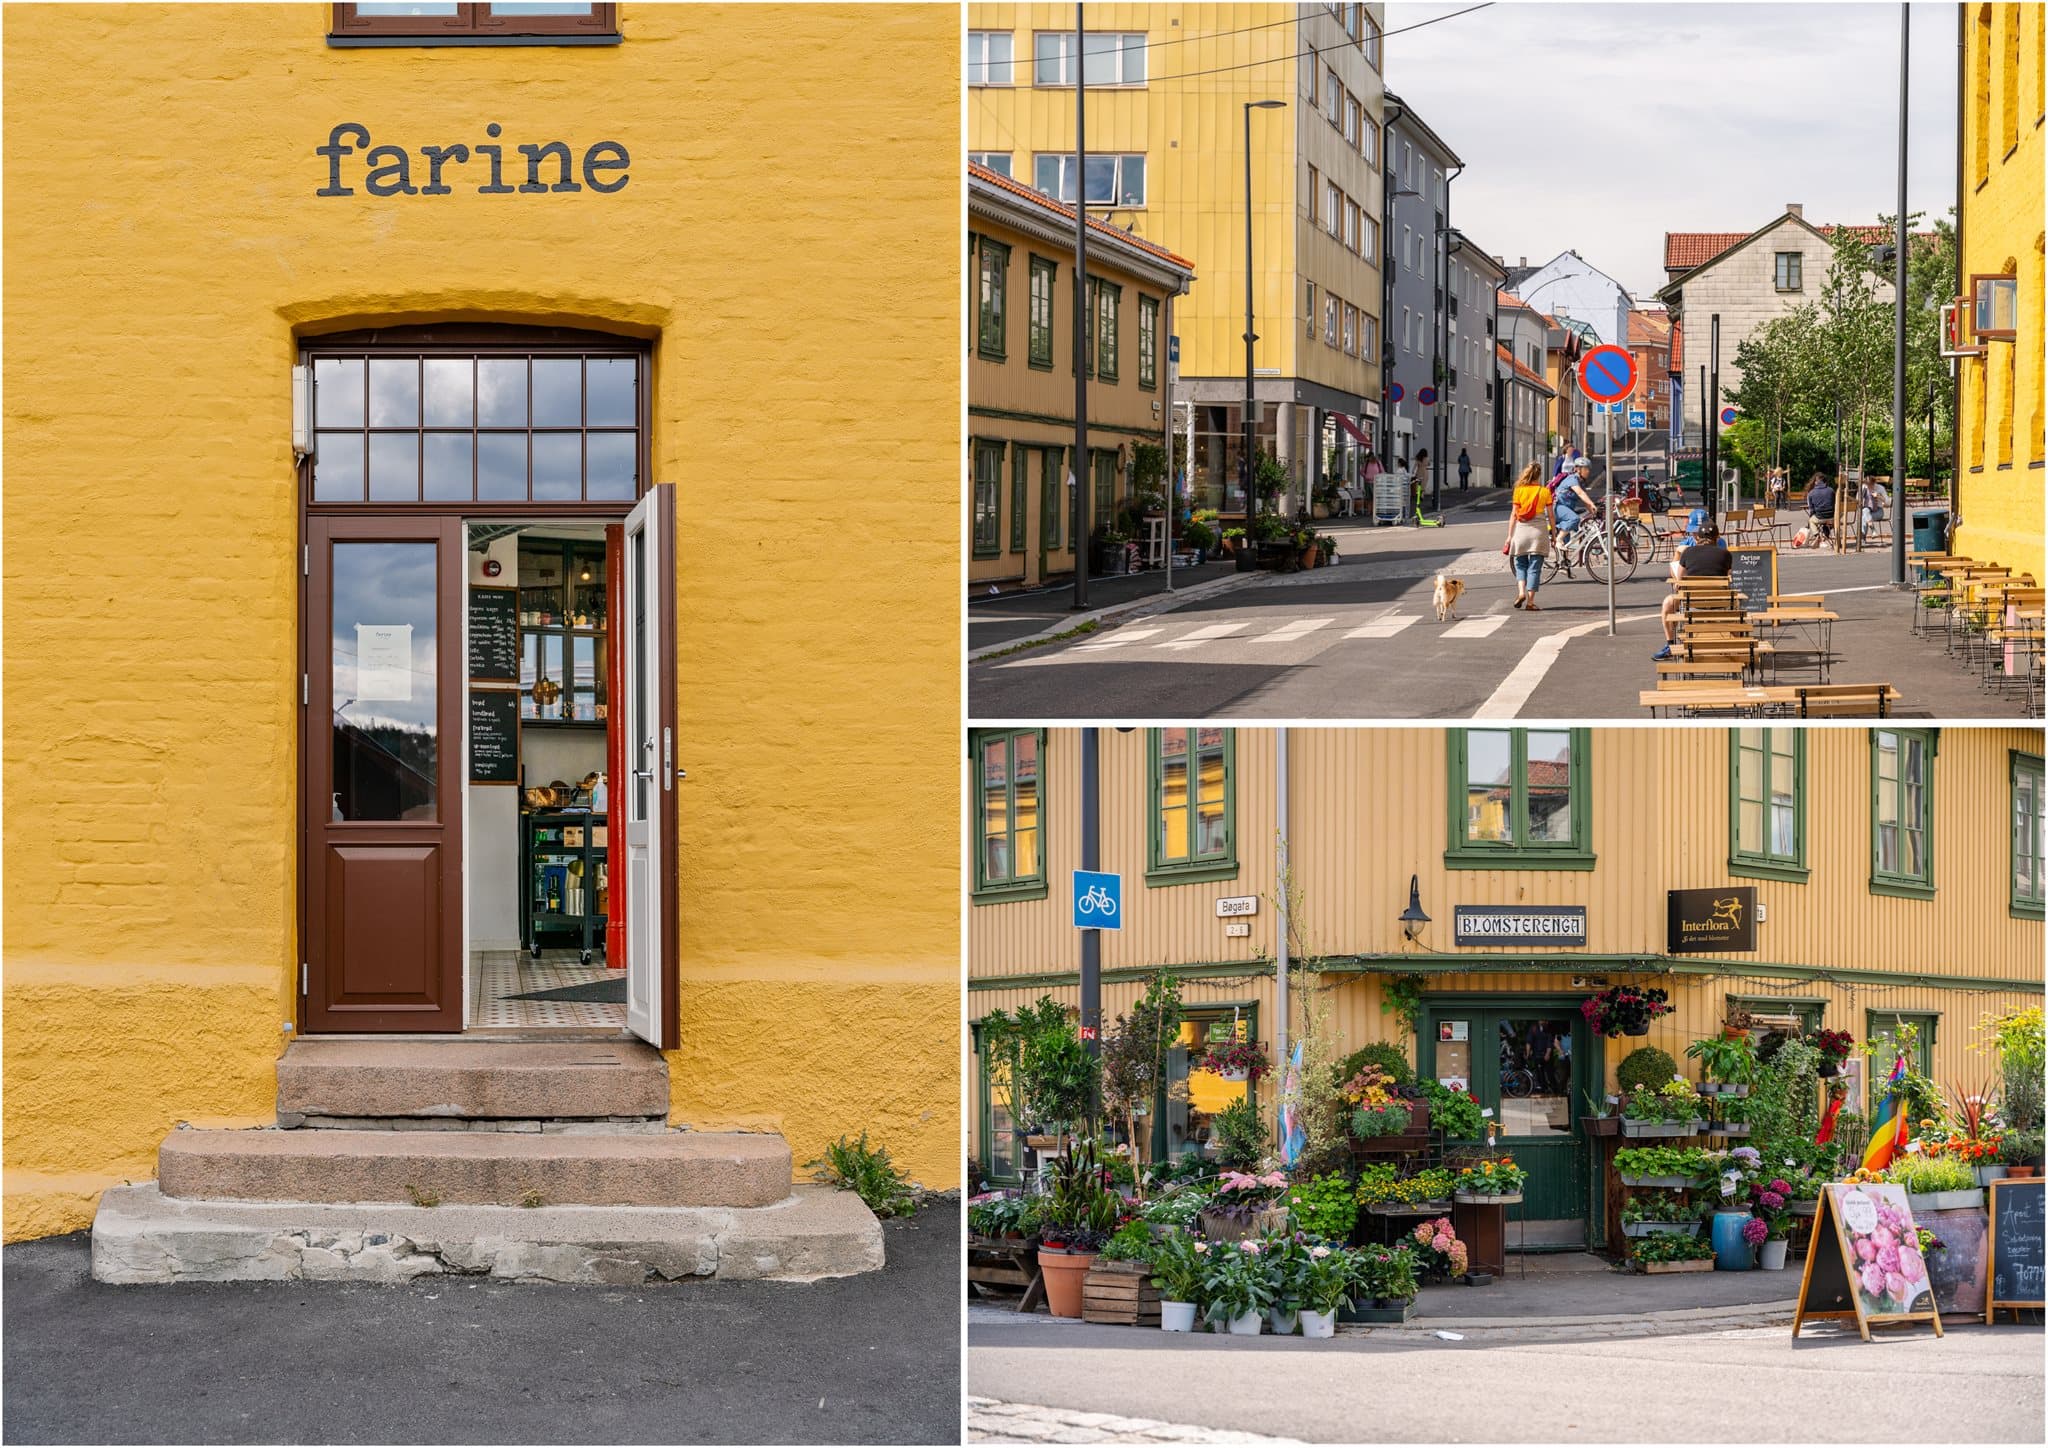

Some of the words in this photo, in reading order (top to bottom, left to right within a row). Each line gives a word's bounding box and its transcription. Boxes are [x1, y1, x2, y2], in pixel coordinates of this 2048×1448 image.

[316, 123, 630, 196] farine
[1223, 901, 1249, 914] Bøgata
[1463, 918, 1579, 933] BLOMSTERENGA
[1681, 918, 1729, 932] Interflora
